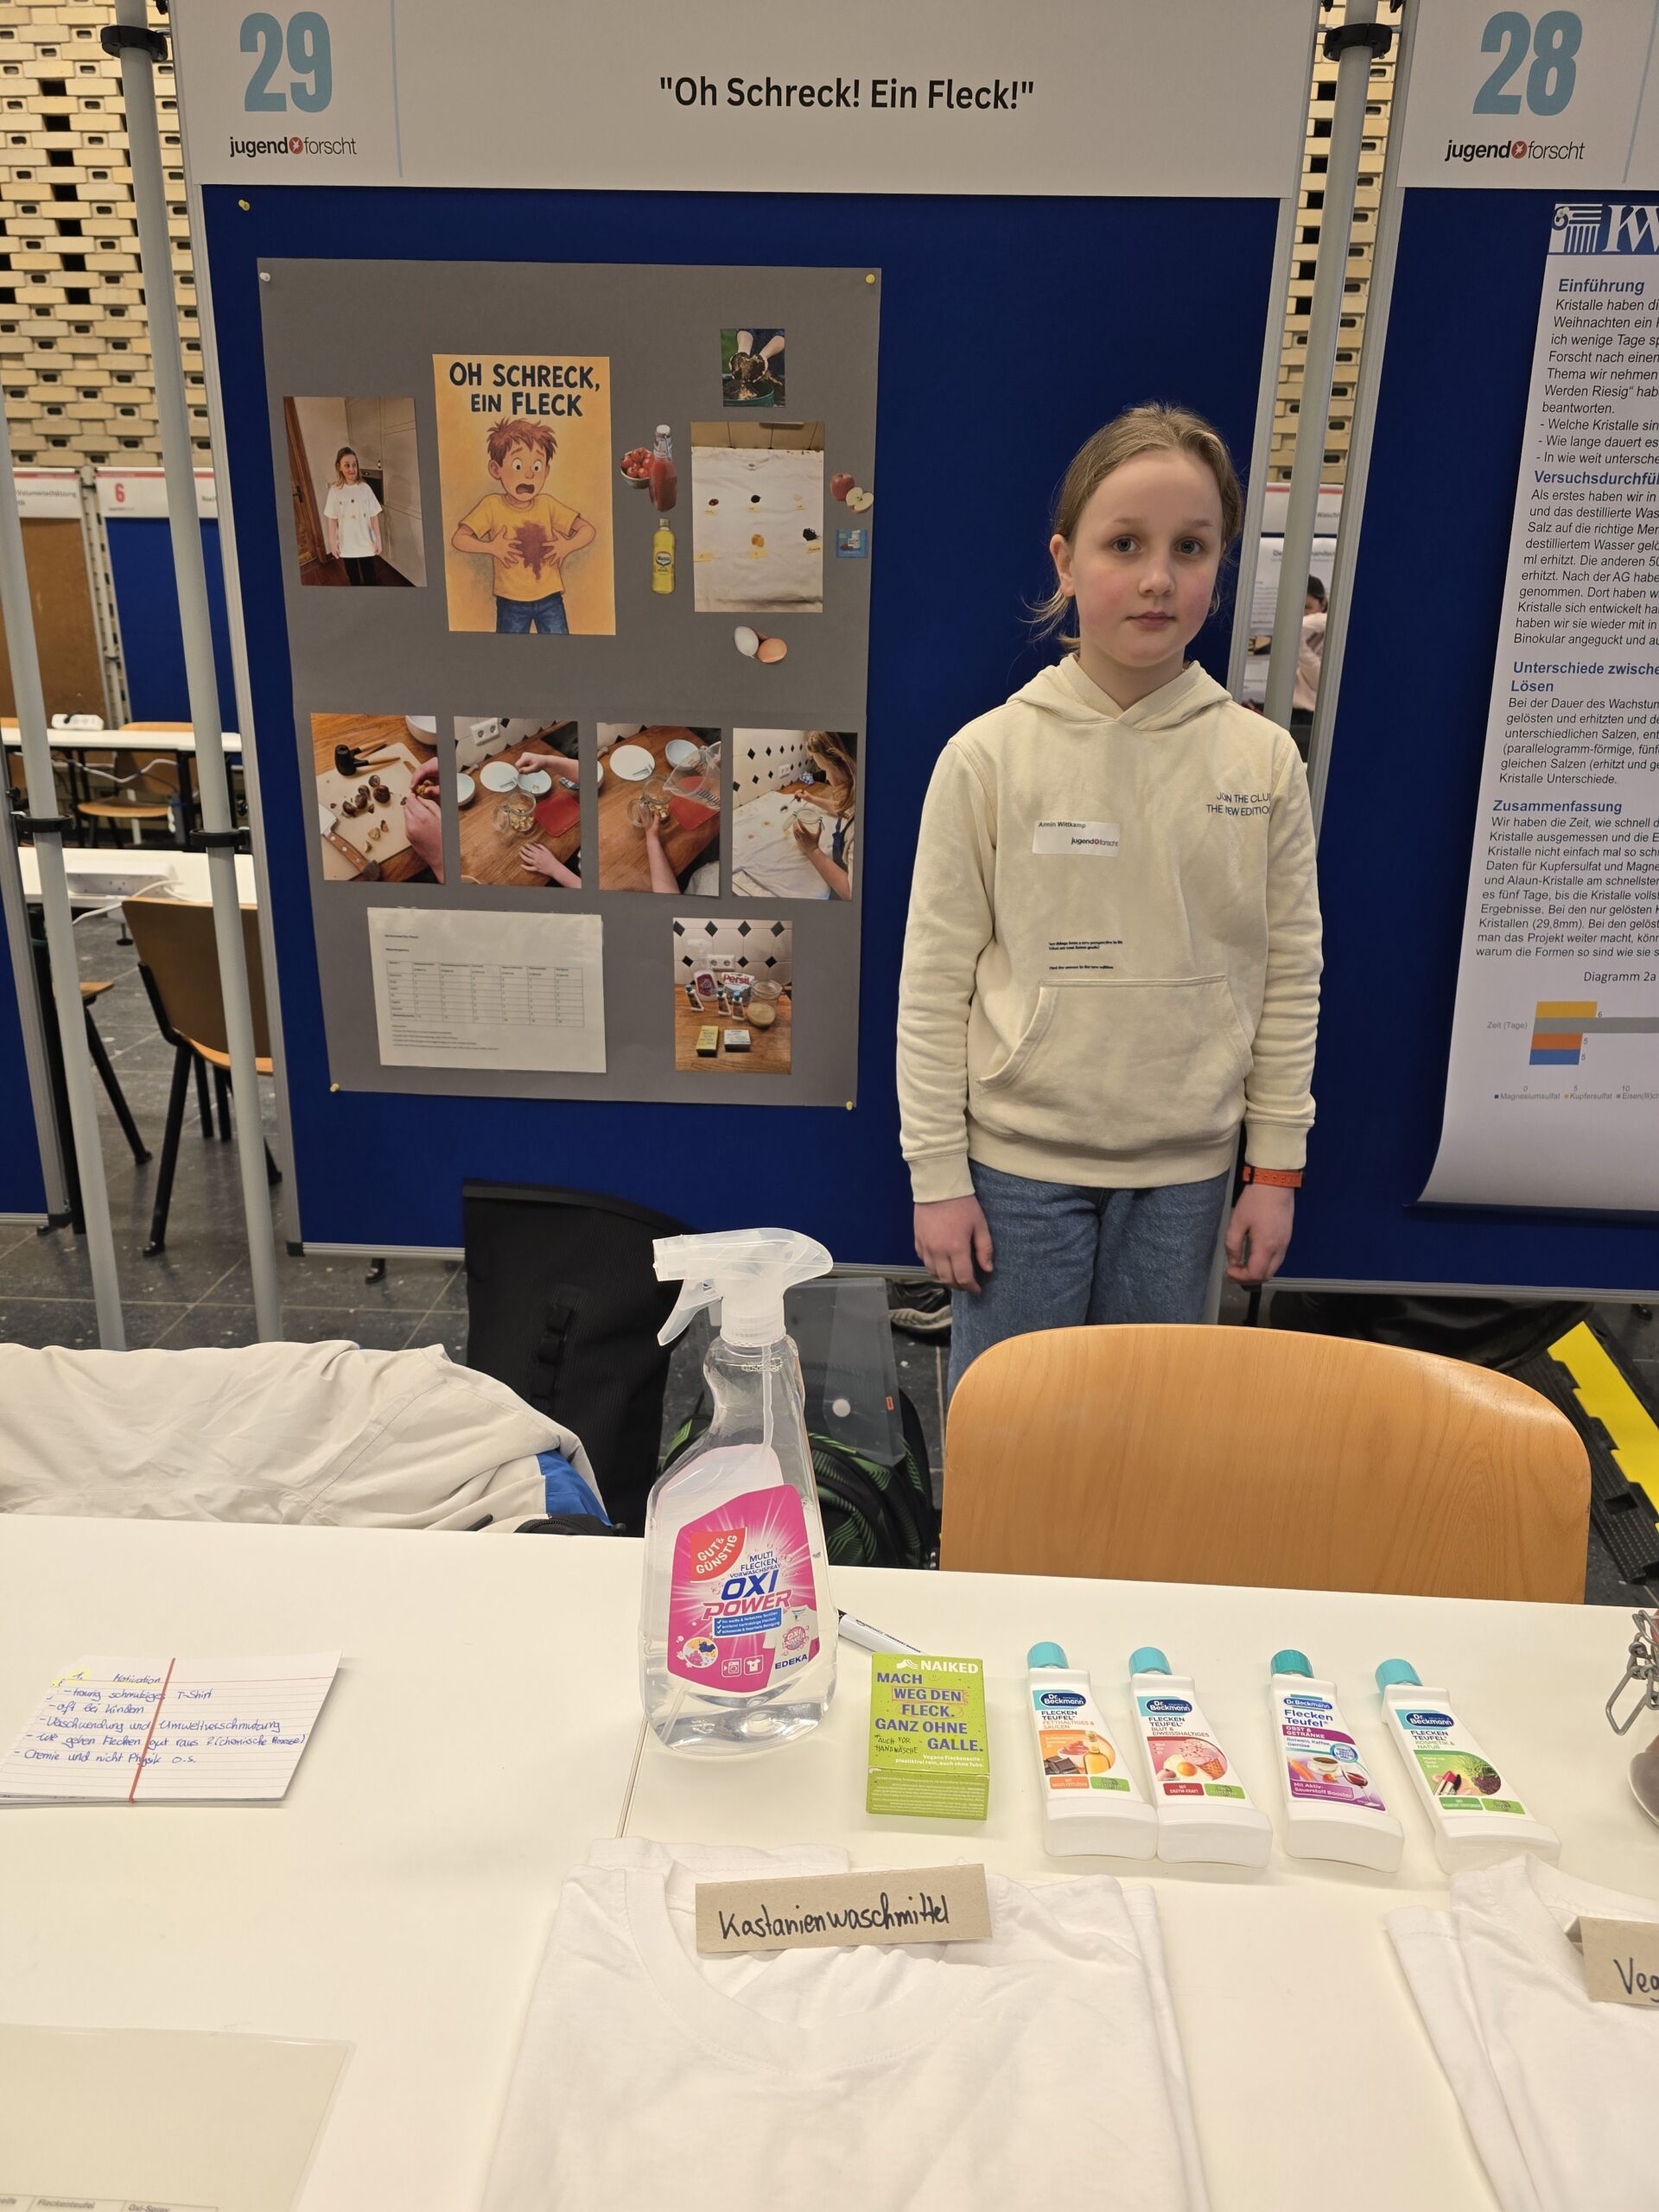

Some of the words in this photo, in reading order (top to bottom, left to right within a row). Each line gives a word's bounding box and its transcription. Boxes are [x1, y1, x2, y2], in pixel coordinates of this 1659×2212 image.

[239, 11, 333, 112] 29
[1472, 10, 1583, 116] 28
[659, 76, 717, 106] "Oh
[727, 76, 860, 108] Schreck!
[871, 78, 917, 109] Ein
[928, 79, 1034, 110] Fleck!"
[1558, 278, 1645, 296] Einführung
[1555, 299, 1604, 310] Kristalle
[1606, 299, 1644, 310] haben
[1554, 316, 1630, 328] Weihnachten
[449, 362, 481, 386] OH
[493, 364, 600, 391] SCHRECK,
[1547, 367, 1586, 379] Thema
[1590, 368, 1608, 379] wir
[1610, 368, 1658, 380] nehmen
[471, 393, 502, 412] EIN
[512, 391, 583, 416] FLECK
[1541, 402, 1614, 414] beantworten.
[1548, 418, 1589, 430] Welche
[1592, 419, 1639, 430] Kristalle
[115, 483, 125, 503] 6
[1525, 537, 1590, 550] destilliertem
[1593, 538, 1635, 550] Wasser
[1517, 601, 1562, 613] Kristalle
[1564, 602, 1586, 613] sich
[1588, 603, 1642, 613] entwickelt
[1513, 632, 1566, 644] Binokular
[1567, 634, 1623, 647] angeguckt
[1625, 634, 1646, 645] und
[1513, 661, 1605, 674] Unterschiede
[1510, 679, 1554, 692] Lösen
[1504, 728, 1599, 739] unterschiedlichen
[1601, 728, 1639, 740] Salzen,
[1503, 743, 1635, 756] (parallelogramm-förmige,
[1499, 772, 1543, 783] Kristalle
[1547, 773, 1617, 784] Unterschiede.
[1234, 794, 1249, 803] THE
[1250, 792, 1270, 803] CLU
[1206, 804, 1224, 813] THE
[1241, 805, 1270, 816] EDITIO
[1492, 799, 1622, 815] Zusammenfassung
[1489, 831, 1534, 842] Kristalle
[1536, 834, 1608, 844] ausgemessen
[1611, 832, 1631, 842] und
[1633, 832, 1649, 842] die
[1485, 860, 1518, 870] Daten
[1522, 860, 1537, 871] für
[1540, 861, 1601, 873] Kupfersulfat
[1604, 861, 1624, 871] und
[1478, 918, 1529, 928] Kristallen
[1532, 918, 1584, 931] (29,8mm).
[1583, 971, 1640, 983] Diagramm
[1643, 971, 1656, 982] 2a
[1569, 1092, 1612, 1101] Kupfersulfat
[696, 1535, 737, 1574] GÜNSTIG
[697, 1544, 720, 1561] GUT
[749, 1551, 773, 1562] MULTI
[741, 1558, 778, 1571] FLECKEN
[721, 1569, 779, 1600] OXI
[702, 1590, 792, 1620] POWER
[774, 1654, 808, 1669] EDEKA
[920, 1660, 979, 1674] NAIKED
[876, 1672, 923, 1684] MACH
[893, 1688, 926, 1700] WEG
[931, 1690, 962, 1701] DEN
[902, 1704, 955, 1718] FLECK.
[1284, 1709, 1333, 1721] Flecken
[874, 1718, 918, 1732] GANZ
[922, 1721, 968, 1734] OHNE
[927, 1738, 983, 1752] GALLE.
[718, 1892, 950, 1940] Kastanienwaschmittel
